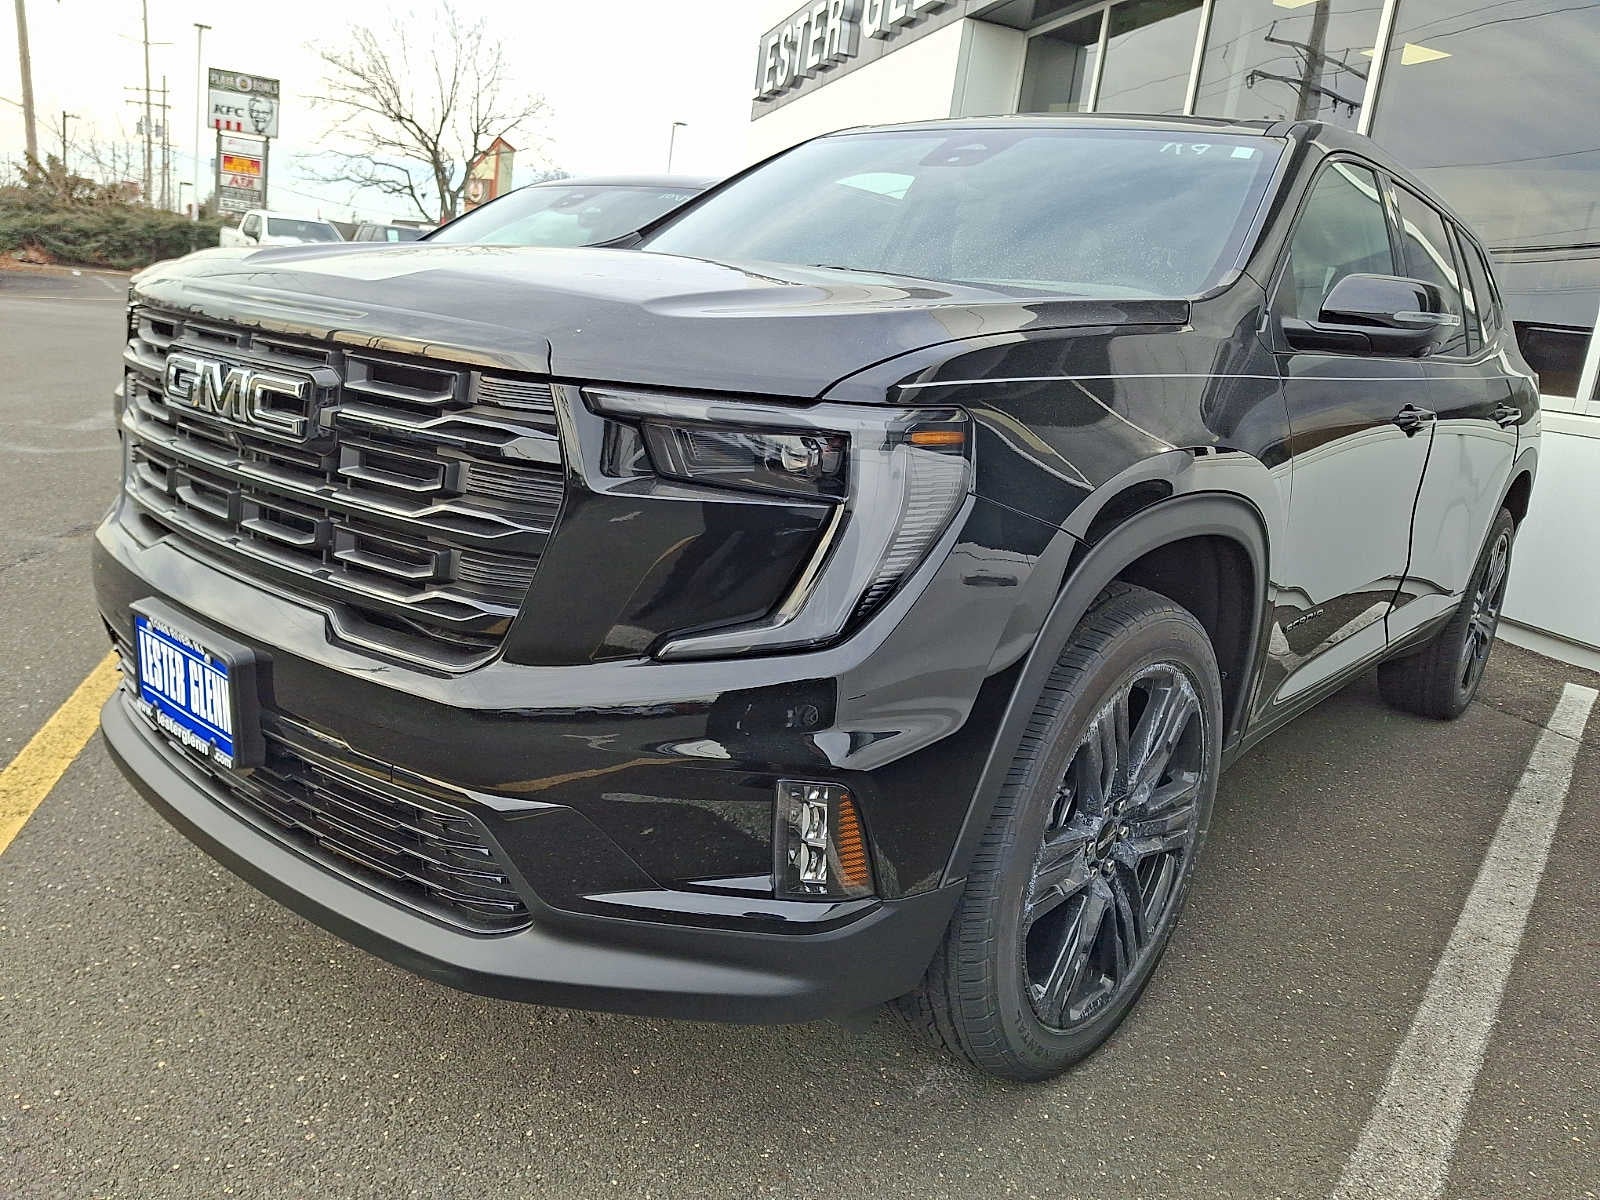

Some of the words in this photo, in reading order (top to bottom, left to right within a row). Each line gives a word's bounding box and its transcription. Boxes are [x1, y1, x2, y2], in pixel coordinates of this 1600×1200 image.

[214, 104, 244, 117] KFC
[165, 354, 309, 436] GMC
[139, 630, 186, 707] LESTER
[188, 658, 232, 735] GLENN
